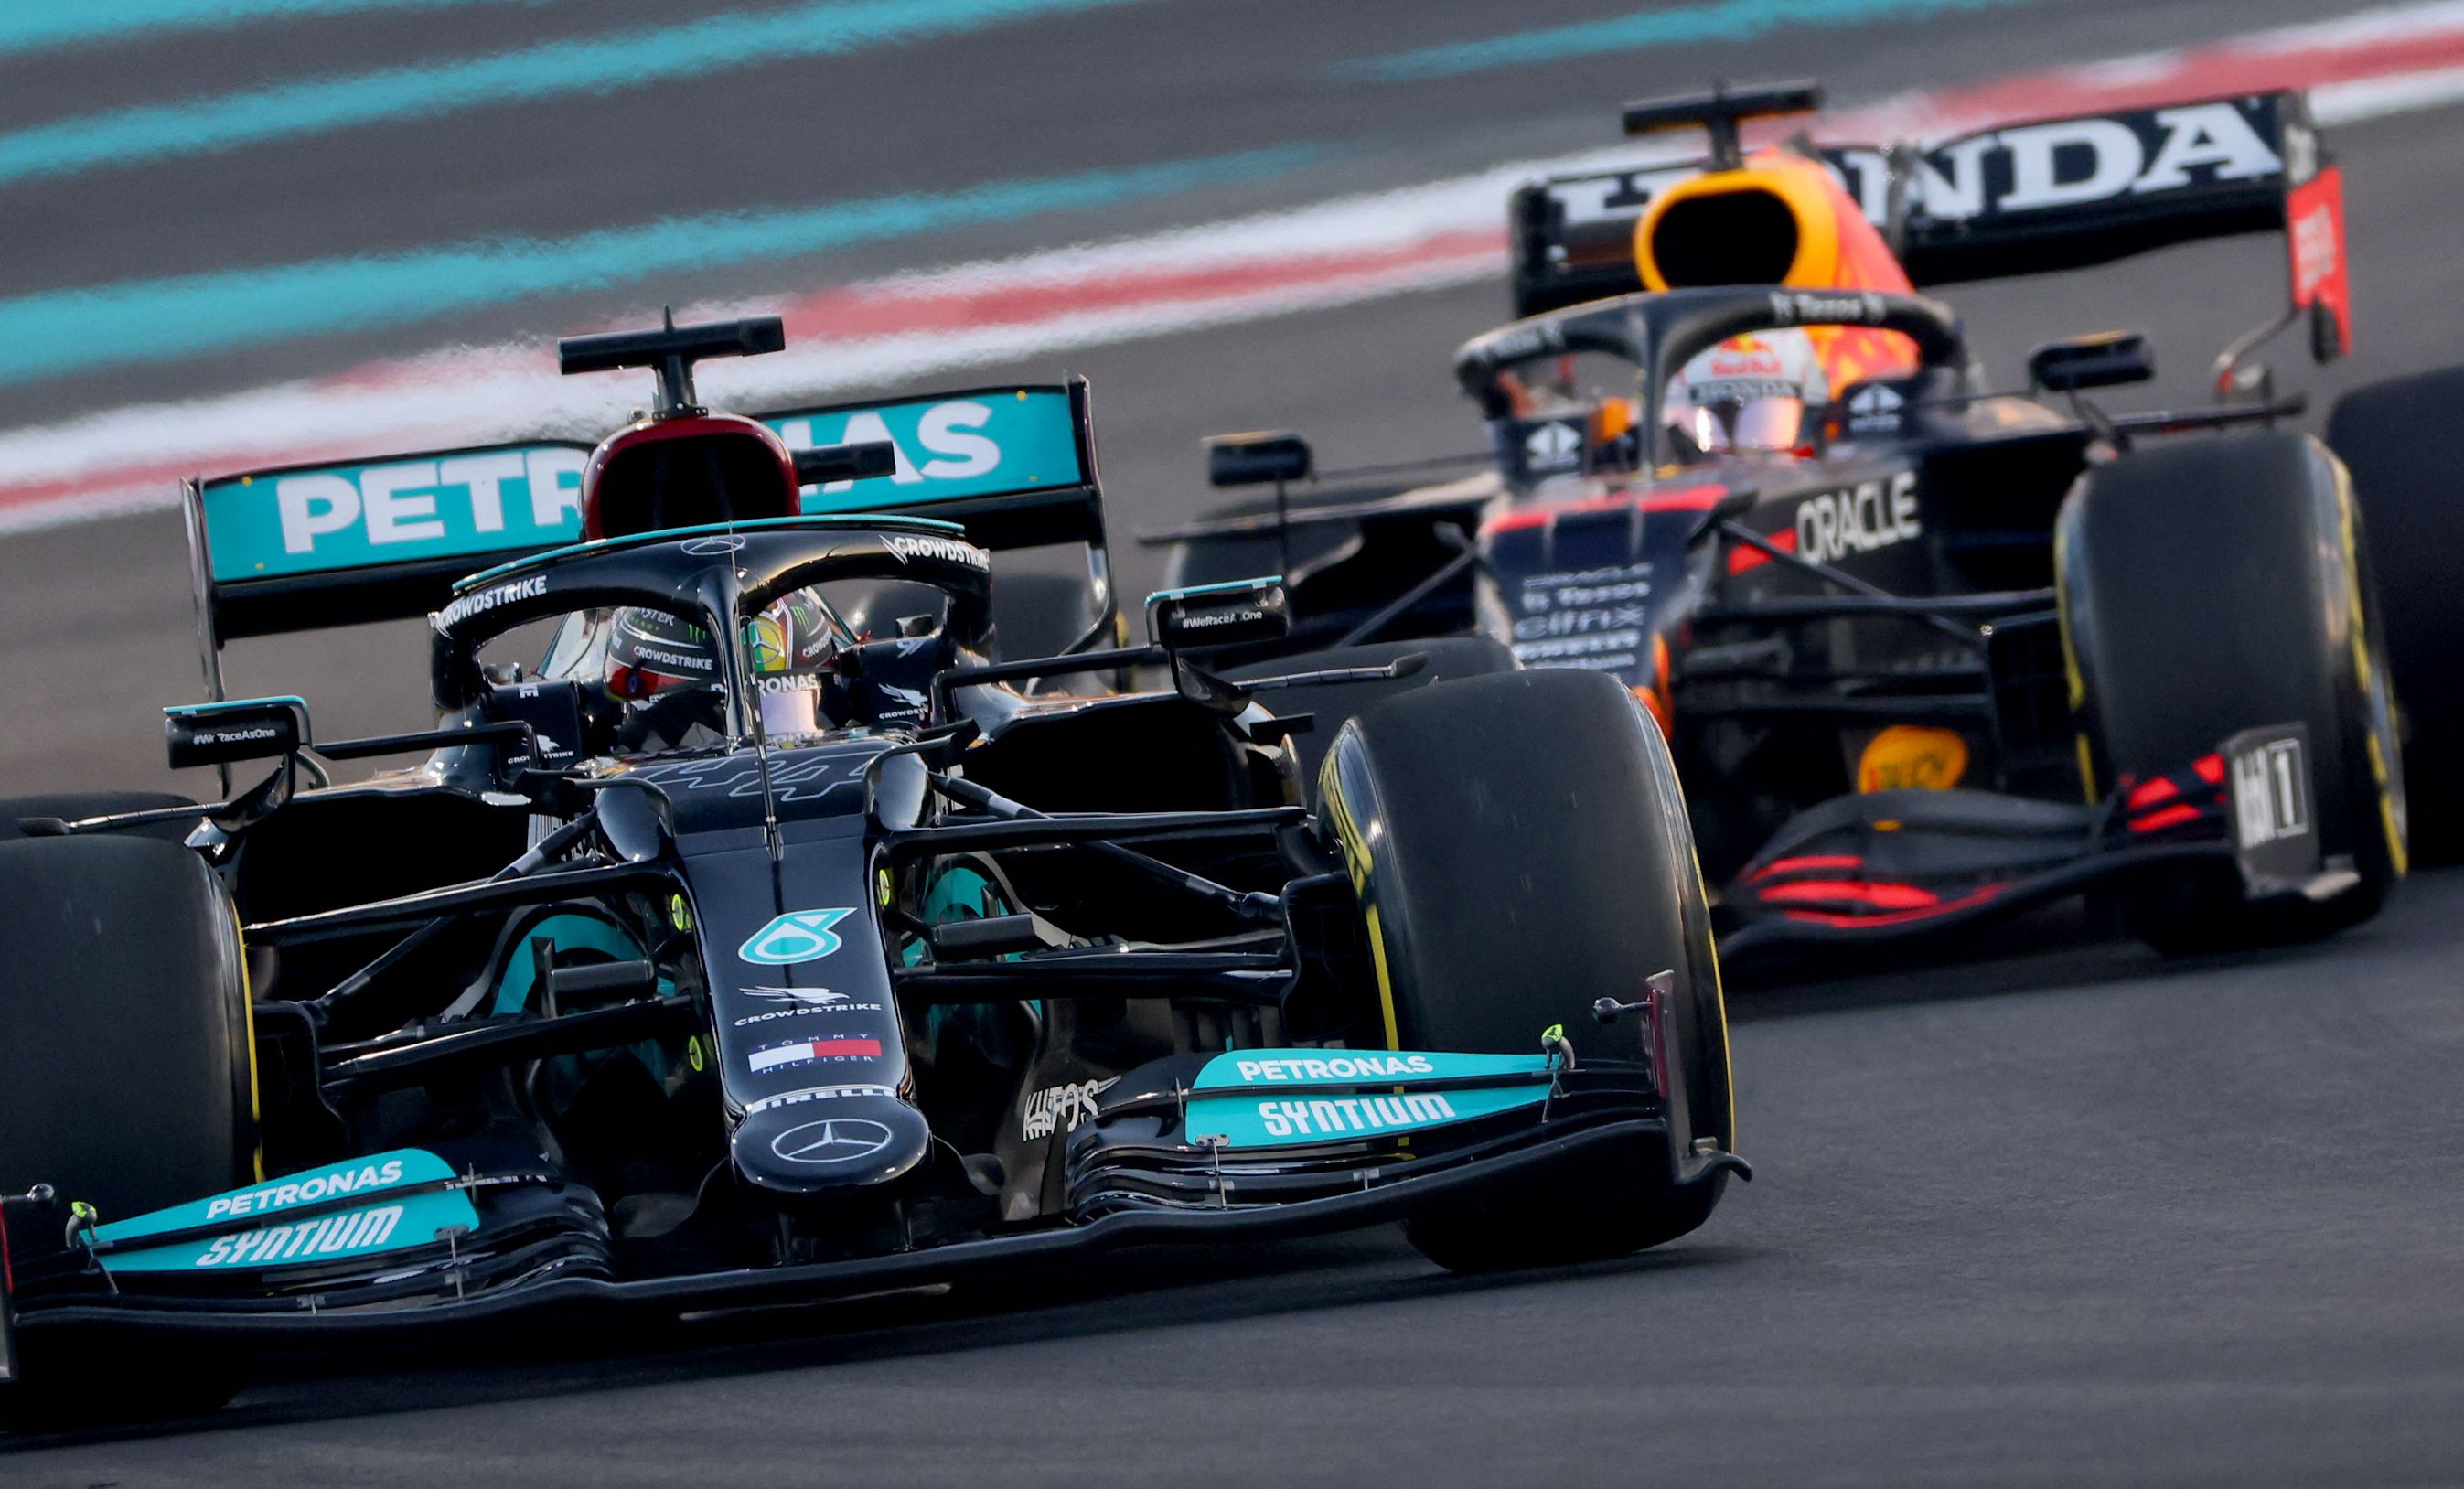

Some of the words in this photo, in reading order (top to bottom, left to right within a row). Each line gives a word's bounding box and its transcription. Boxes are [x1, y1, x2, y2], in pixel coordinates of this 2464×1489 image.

[276, 401, 1002, 554] PETRAS
[1795, 470, 1921, 565] ORACLE
[894, 537, 990, 572] CROWDSTRI
[1183, 610, 1263, 629] #WeRaceAOne
[633, 645, 713, 670] CROWDSTRIKE
[734, 1003, 882, 1026] CROWDSTRIKE
[759, 1033, 869, 1051] TOMMY
[762, 1055, 873, 1075] HILFIGER
[1237, 1055, 1433, 1082] PETRONAS
[1258, 1094, 1456, 1136] SYNTIUM
[207, 1160, 403, 1219] PETRONAS
[196, 1205, 405, 1267] SYNTIUM
